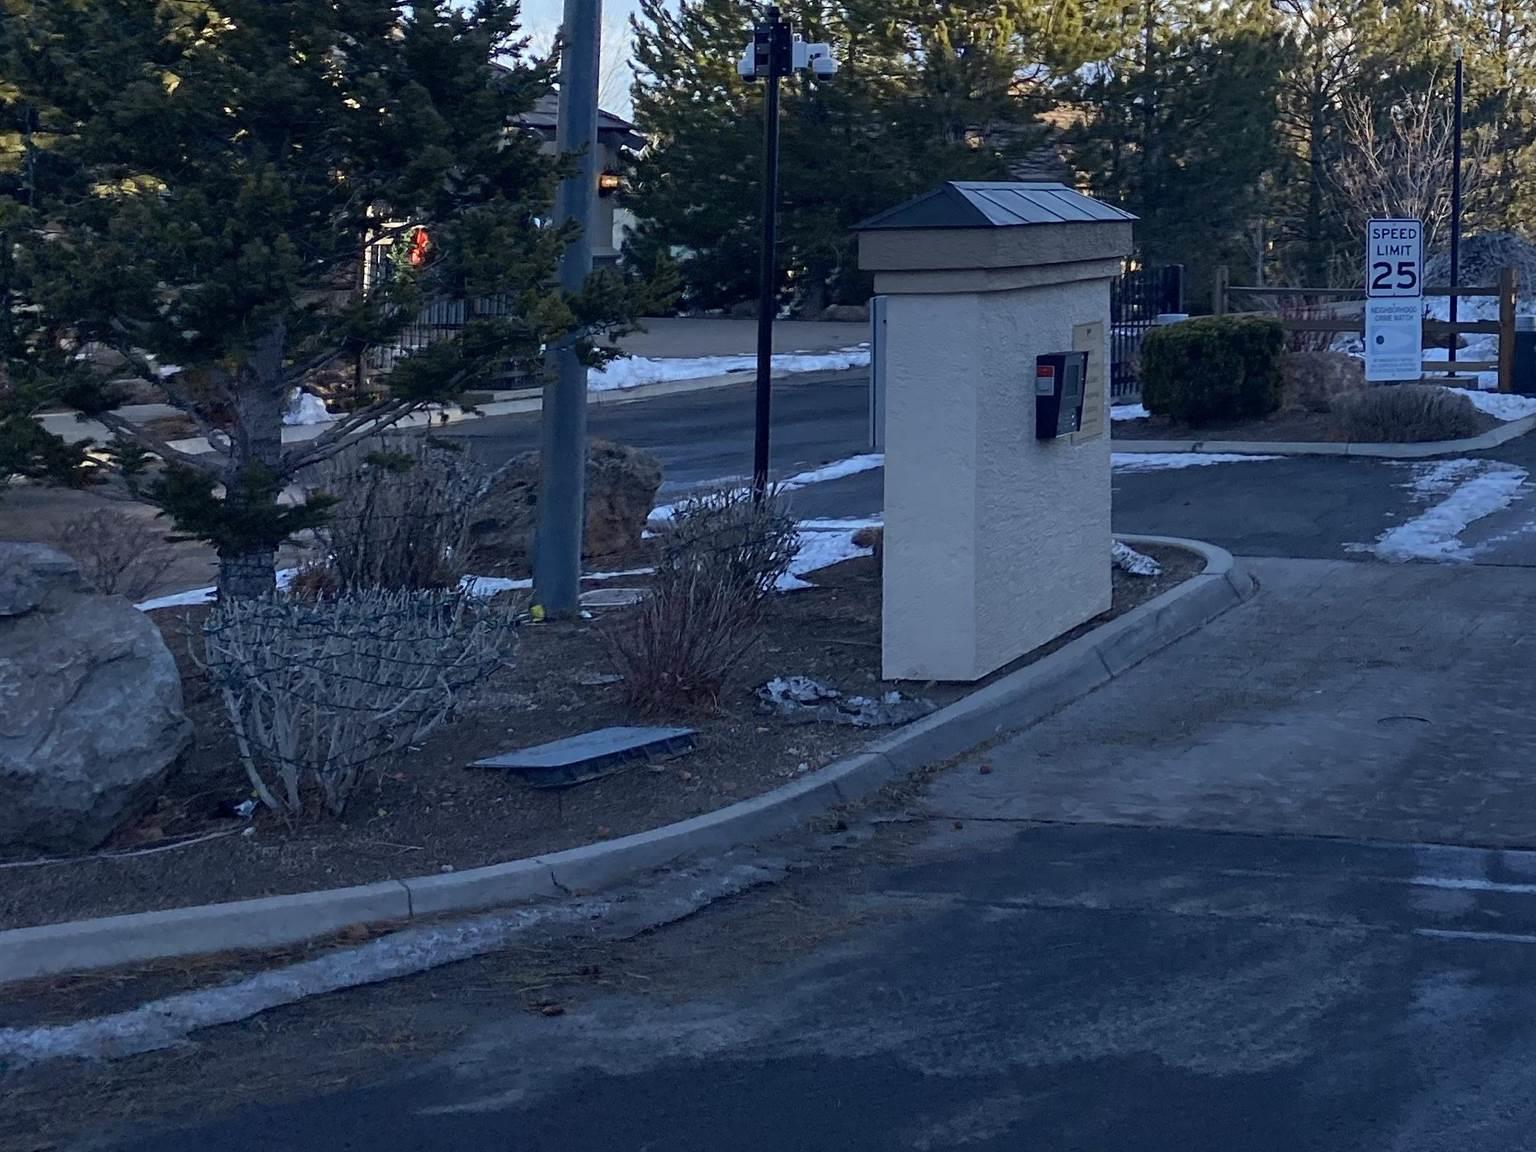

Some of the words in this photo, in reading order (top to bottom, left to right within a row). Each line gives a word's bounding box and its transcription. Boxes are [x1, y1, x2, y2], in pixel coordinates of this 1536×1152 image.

[1372, 228, 1417, 240] SPEED
[1377, 245, 1412, 256] LIMIT
[1371, 261, 1417, 290] 25
